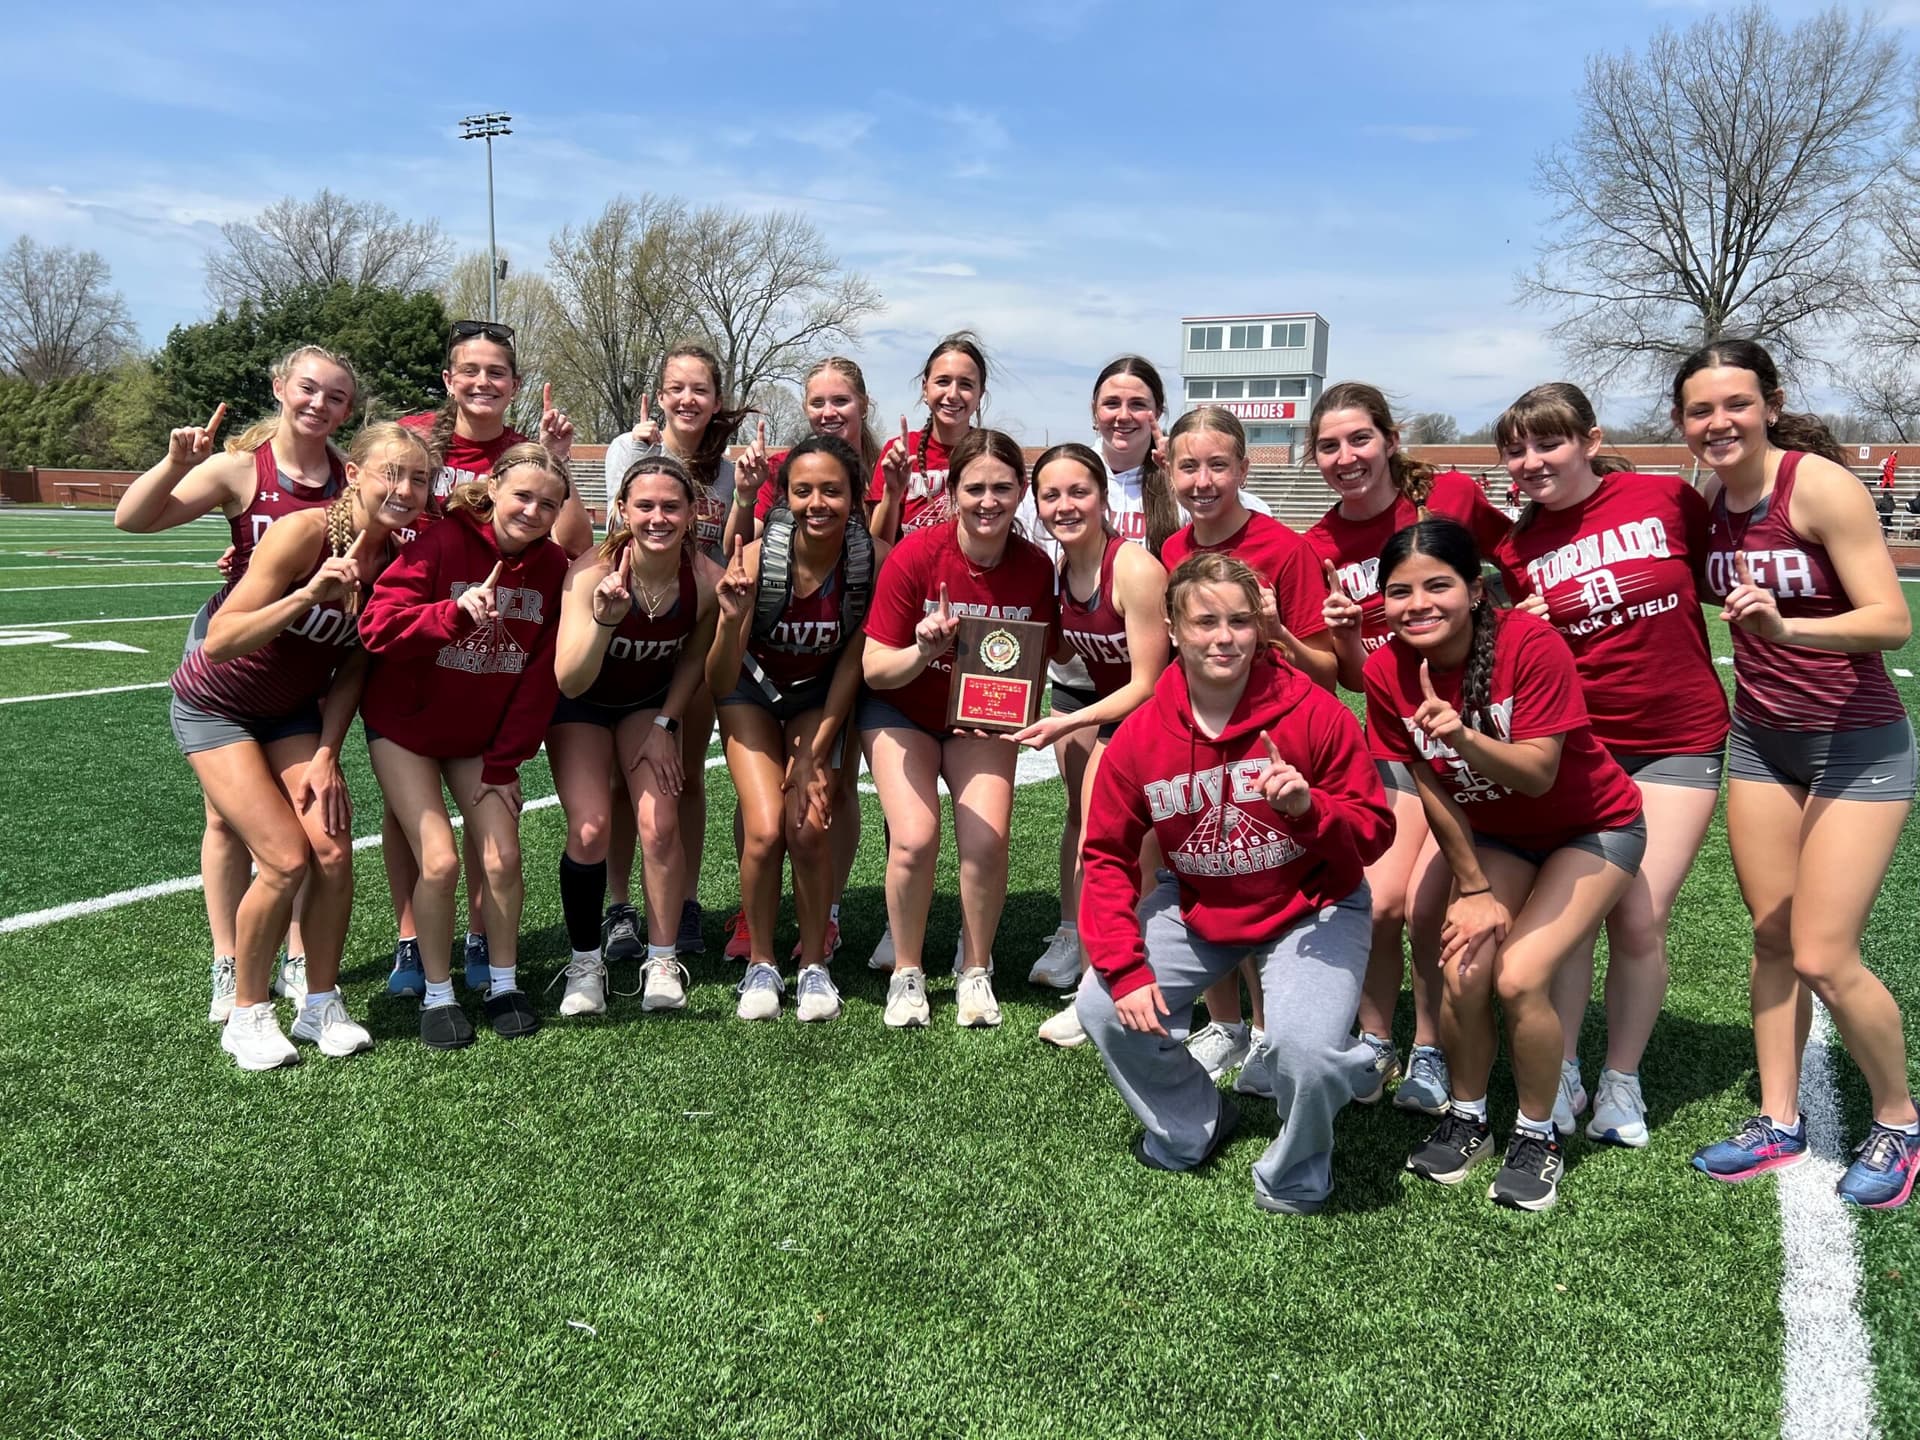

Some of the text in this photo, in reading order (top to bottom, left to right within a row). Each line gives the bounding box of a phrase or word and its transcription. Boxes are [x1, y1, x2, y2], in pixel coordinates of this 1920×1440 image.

[1216, 403, 1284, 419] RNADOES
[1527, 516, 1671, 596] TORNADO
[1706, 548, 1816, 598] OVER
[1611, 610, 1624, 626] &
[1627, 593, 1679, 620] FIELD
[1063, 629, 1131, 663] OVER
[1144, 758, 1273, 822] DOVE
[1186, 843, 1194, 853] 1
[1201, 843, 1210, 853] 2
[1250, 835, 1261, 846] 5
[1266, 831, 1278, 841] 6
[1168, 851, 1237, 877] TRACK
